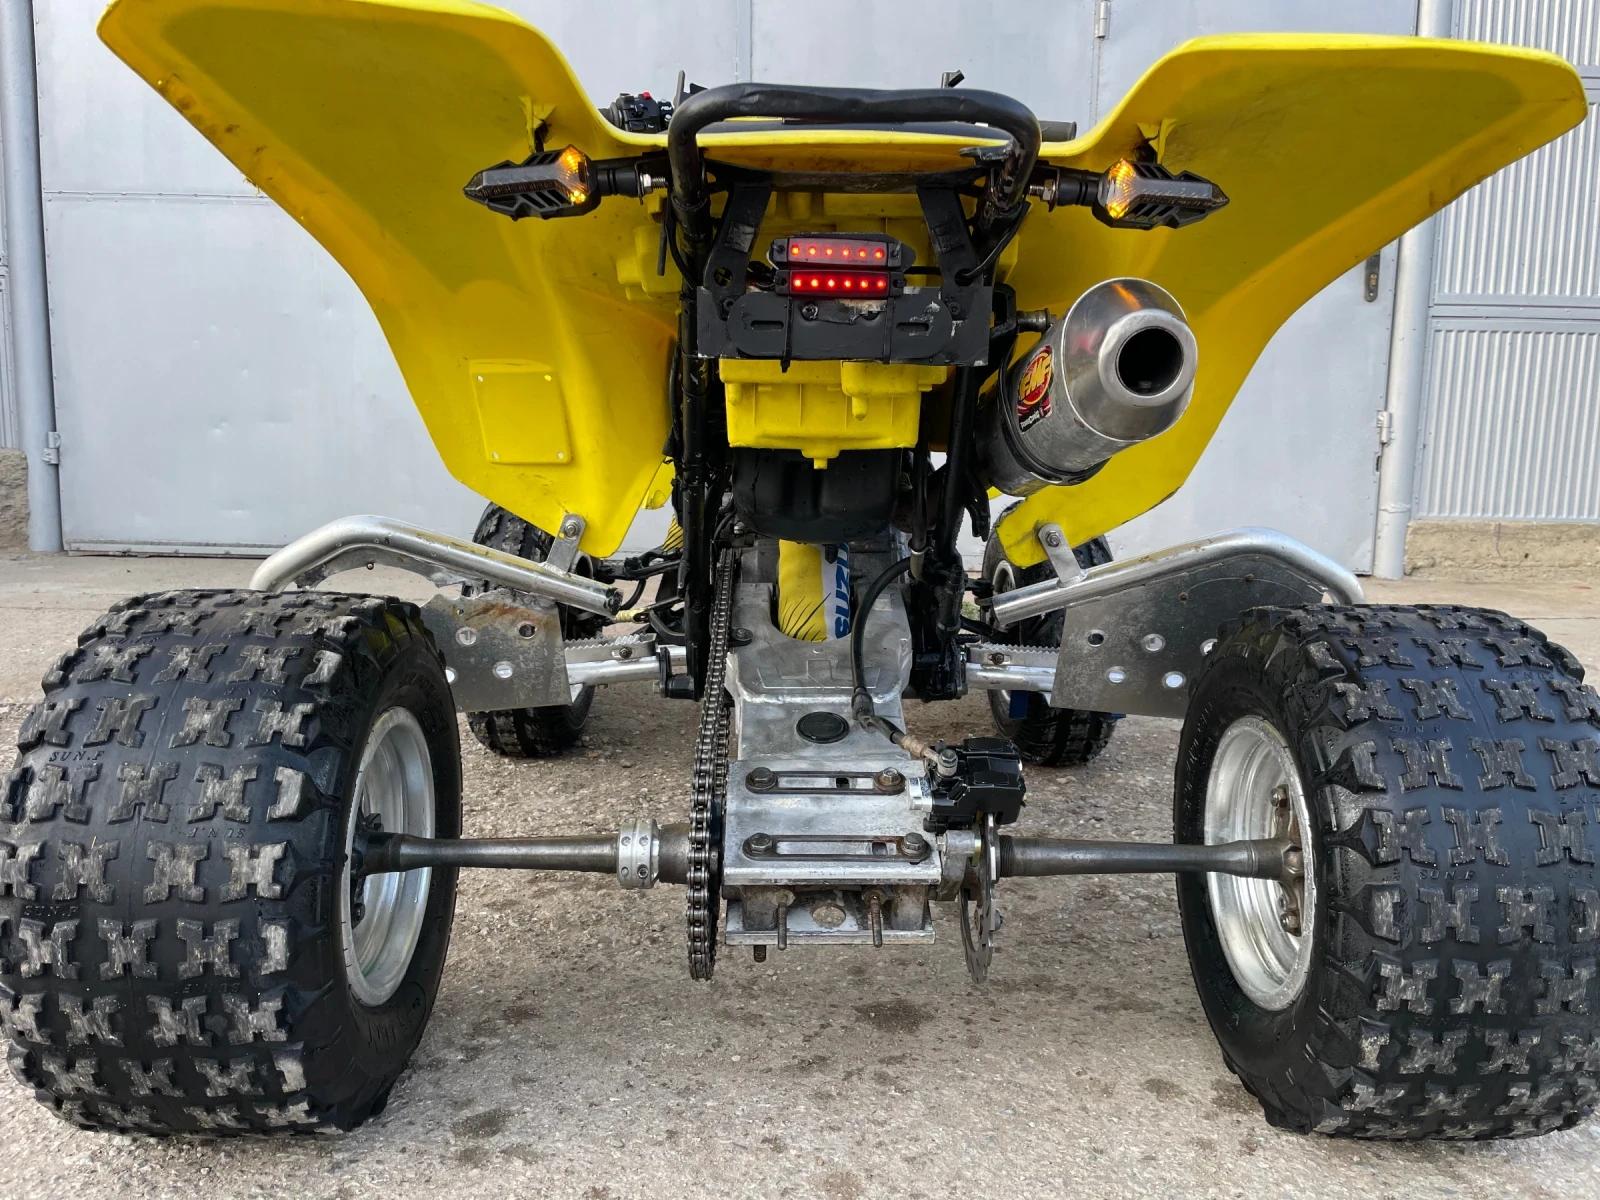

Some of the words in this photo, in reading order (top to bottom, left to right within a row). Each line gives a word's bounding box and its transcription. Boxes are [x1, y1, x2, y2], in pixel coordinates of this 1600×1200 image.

[1019, 355, 1052, 400] FMF
[49, 750, 105, 763] SUN.F
[188, 828, 247, 838] SUN.F
[1419, 870, 1475, 881] SUN.F
[24, 905, 79, 917] SUN.F
